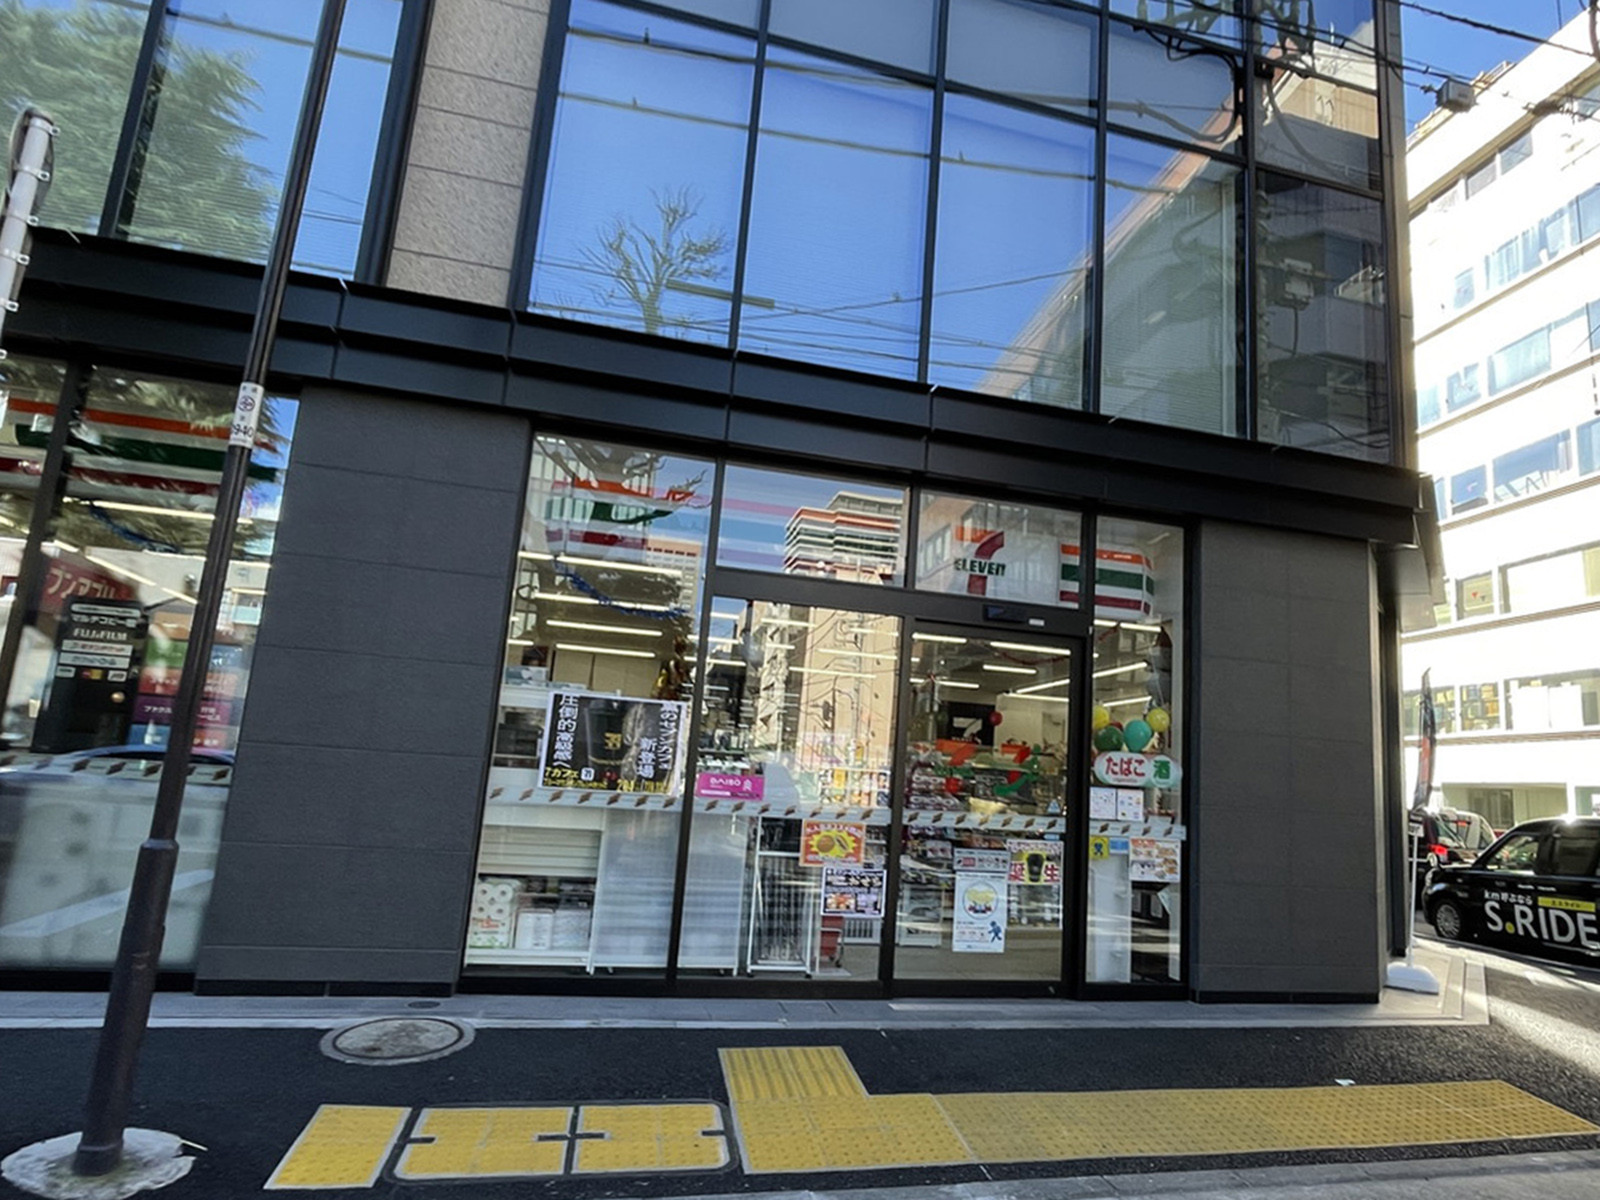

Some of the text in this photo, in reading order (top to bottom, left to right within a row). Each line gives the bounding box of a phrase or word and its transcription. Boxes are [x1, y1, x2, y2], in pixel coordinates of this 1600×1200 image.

[73, 628, 128, 641] FUJIFILM
[1105, 755, 1171, 779] たばこ 酒
[1484, 900, 1600, 950] S.RIDE
